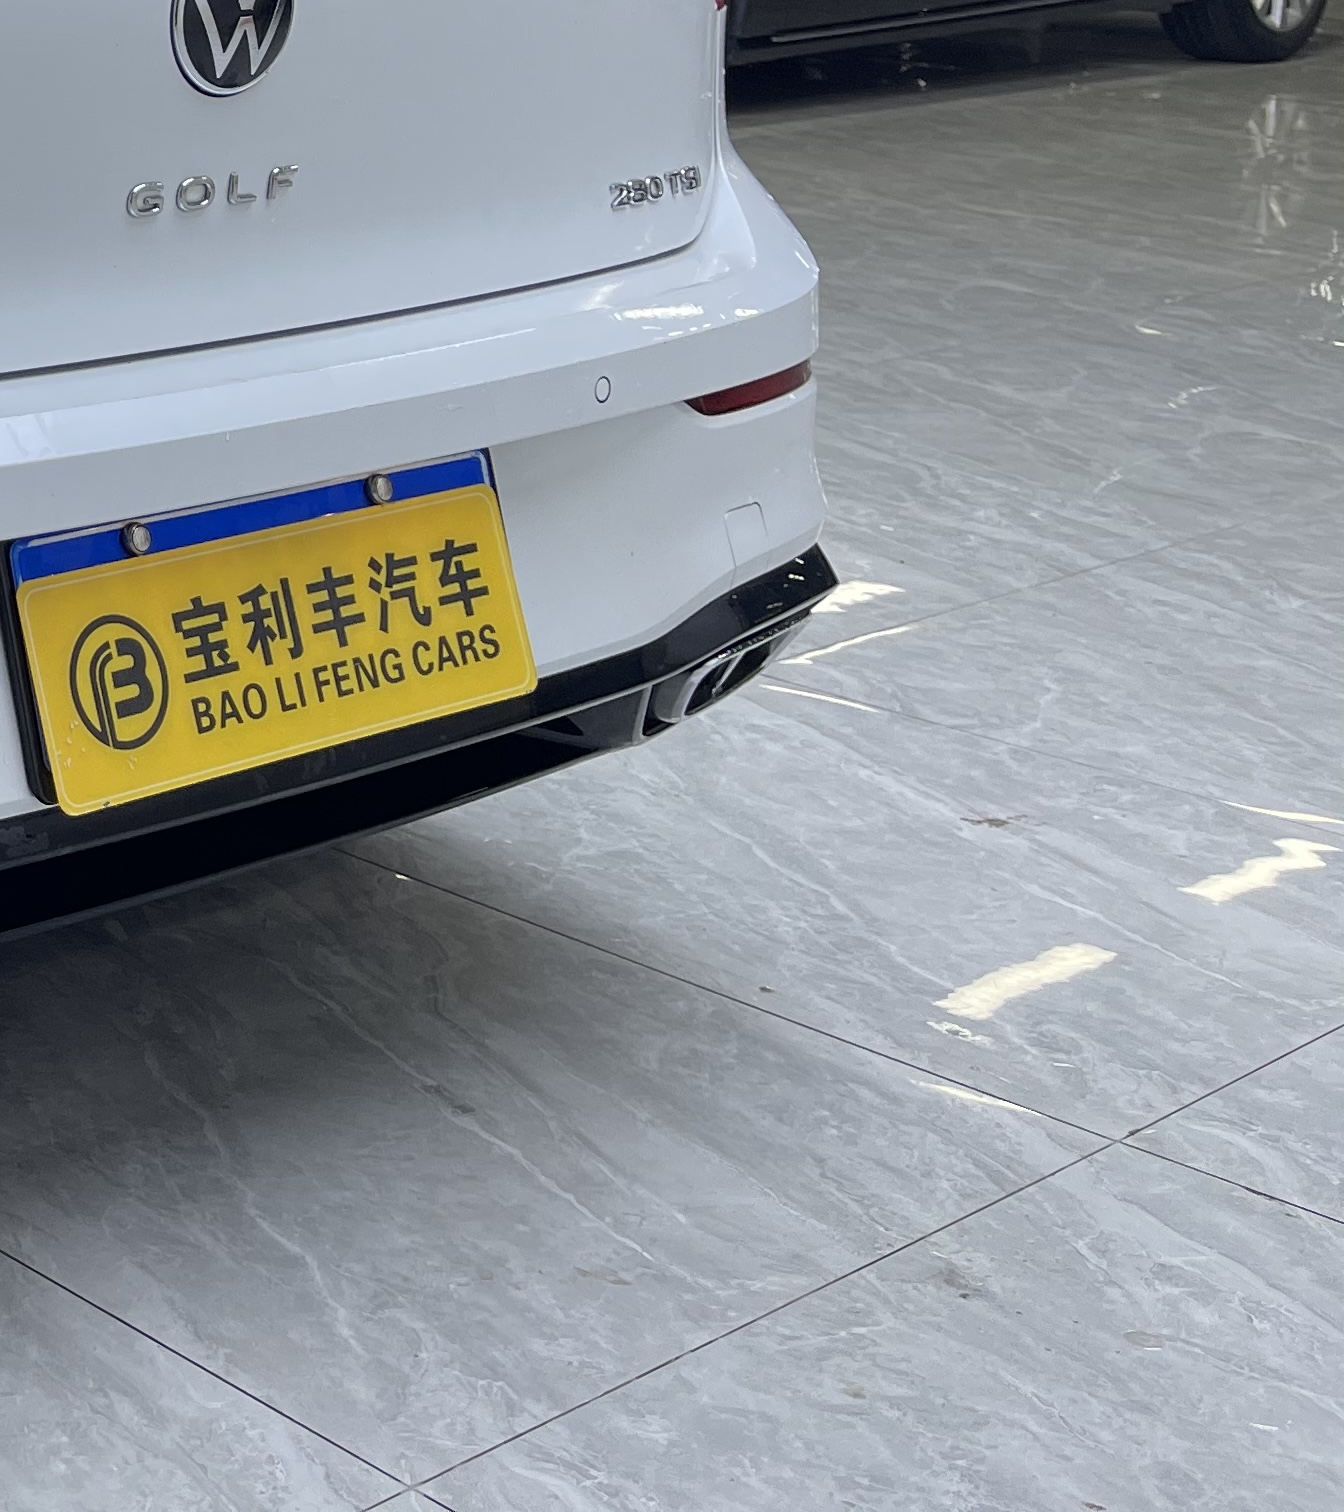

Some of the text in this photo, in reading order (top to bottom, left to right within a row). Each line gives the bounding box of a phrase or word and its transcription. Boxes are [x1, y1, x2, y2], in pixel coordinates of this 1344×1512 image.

[125, 165, 299, 218] GOLF
[609, 175, 664, 211] 280
[171, 539, 491, 683] 宝利丰汽车
[191, 683, 268, 735] BAO
[312, 648, 406, 704] FENG
[412, 623, 501, 677] CARS
